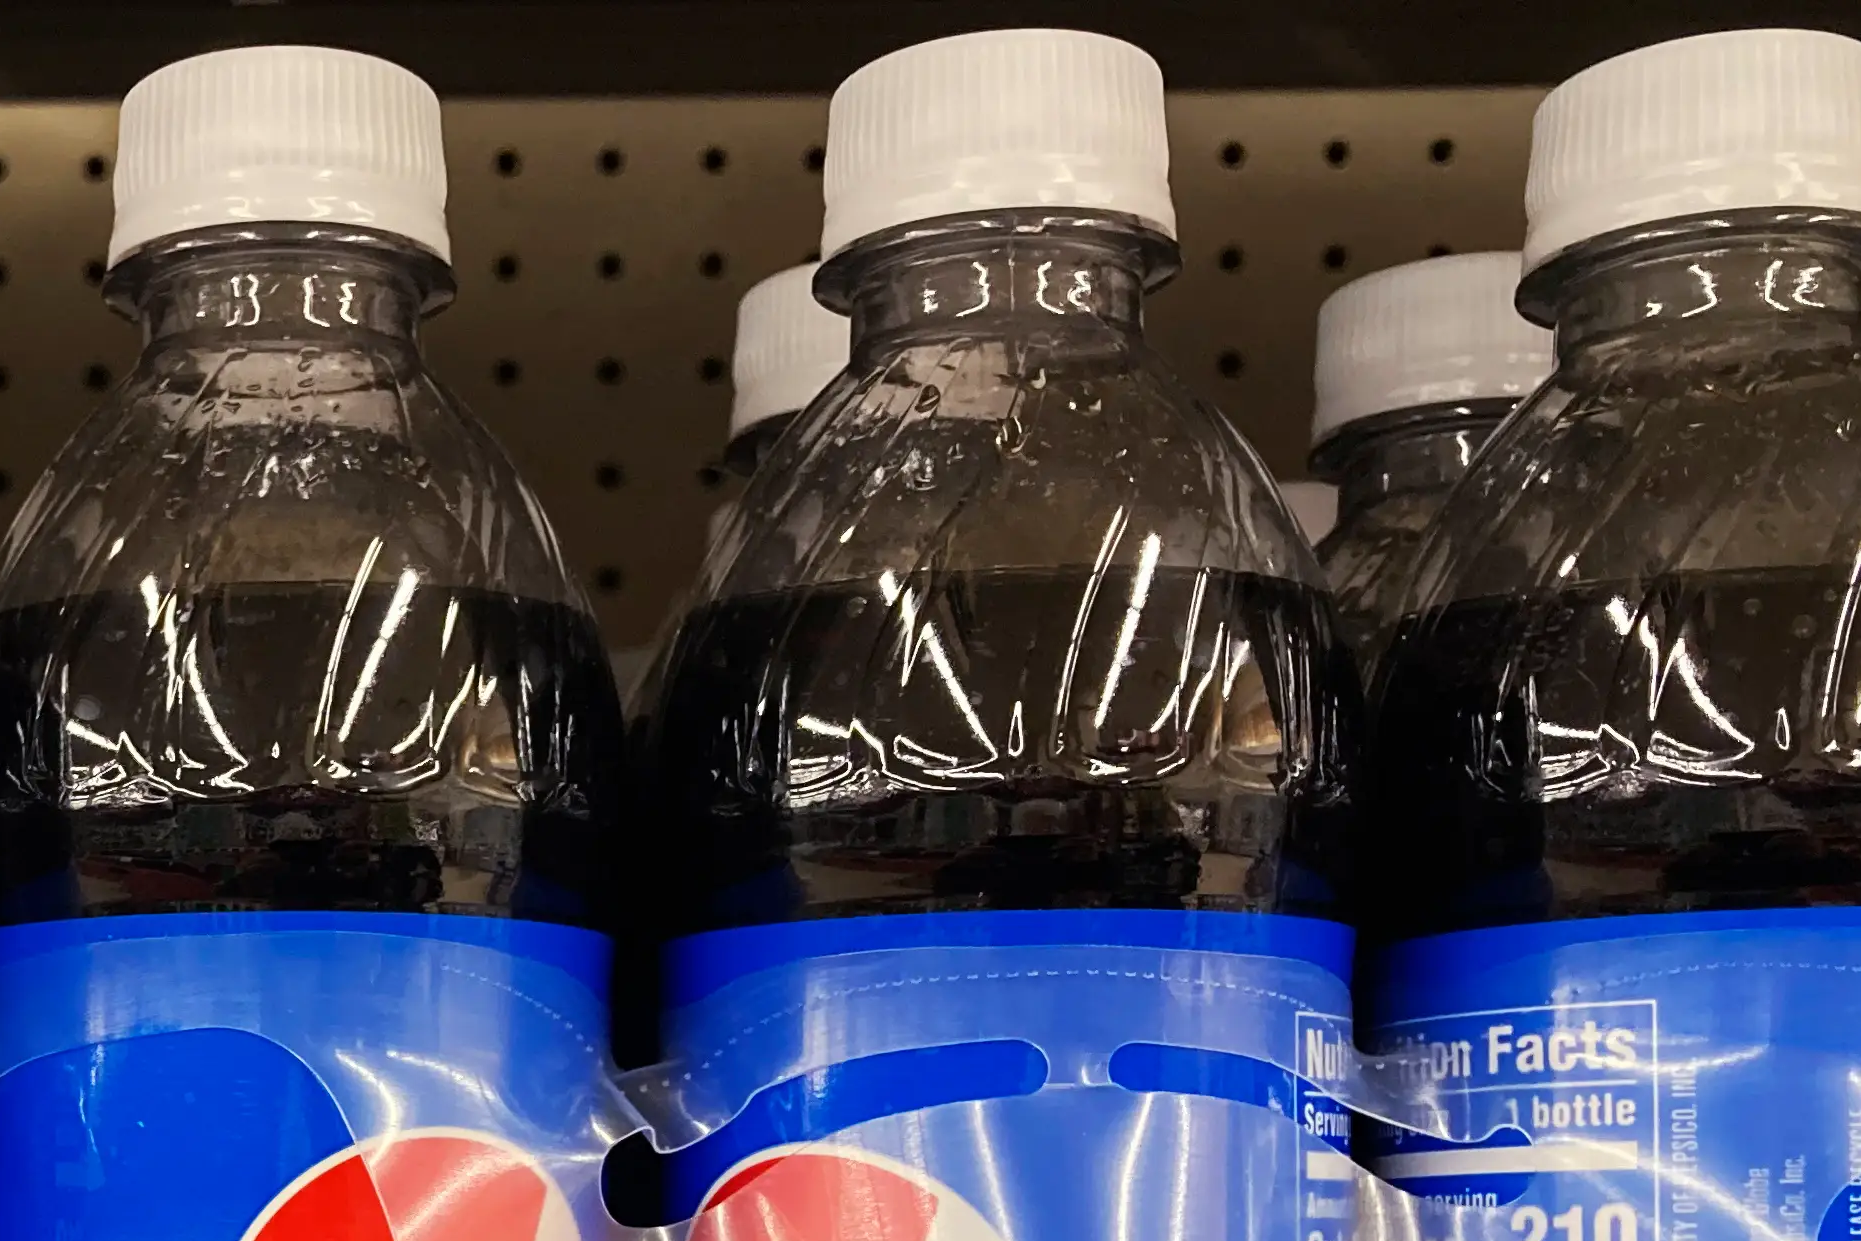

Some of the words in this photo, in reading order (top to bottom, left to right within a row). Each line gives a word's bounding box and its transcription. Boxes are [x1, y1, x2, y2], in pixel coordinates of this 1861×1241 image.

[1488, 1020, 1637, 1076] Facts
[1531, 1092, 1637, 1129] bottle
[1672, 1190, 1698, 1213] OF
